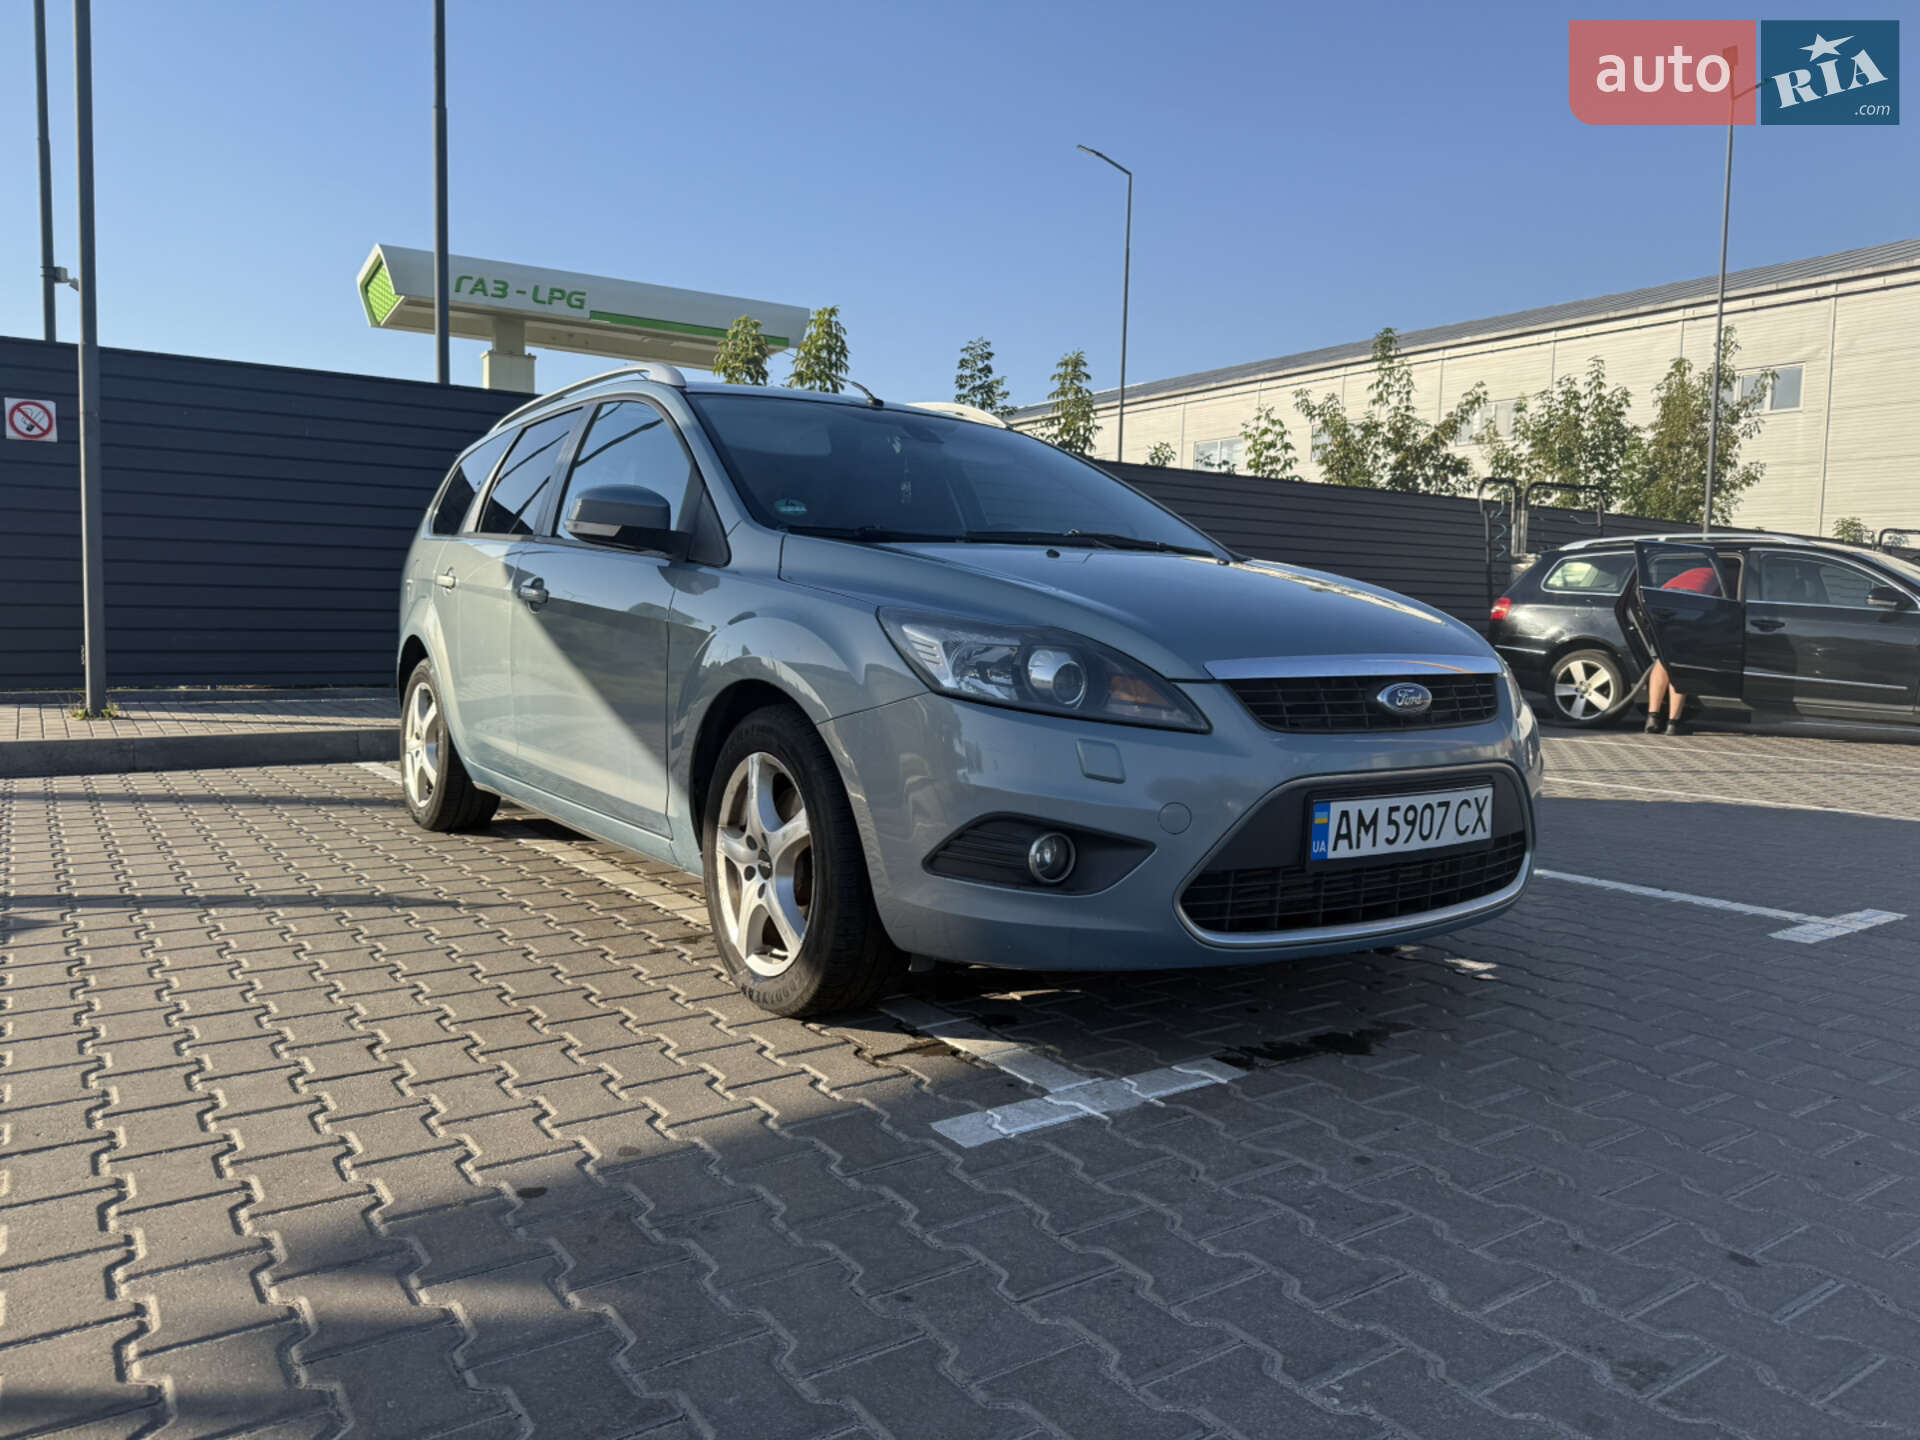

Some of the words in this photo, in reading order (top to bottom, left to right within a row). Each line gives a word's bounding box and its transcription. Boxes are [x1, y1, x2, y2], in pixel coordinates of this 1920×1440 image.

[454, 275, 509, 299] ГАЗ
[531, 284, 587, 310] LPG
[1395, 688, 1422, 706] Ford
[1332, 807, 1380, 852] AM
[1384, 800, 1451, 846] 5907
[1454, 795, 1489, 837] CX
[1312, 840, 1327, 853] UA
